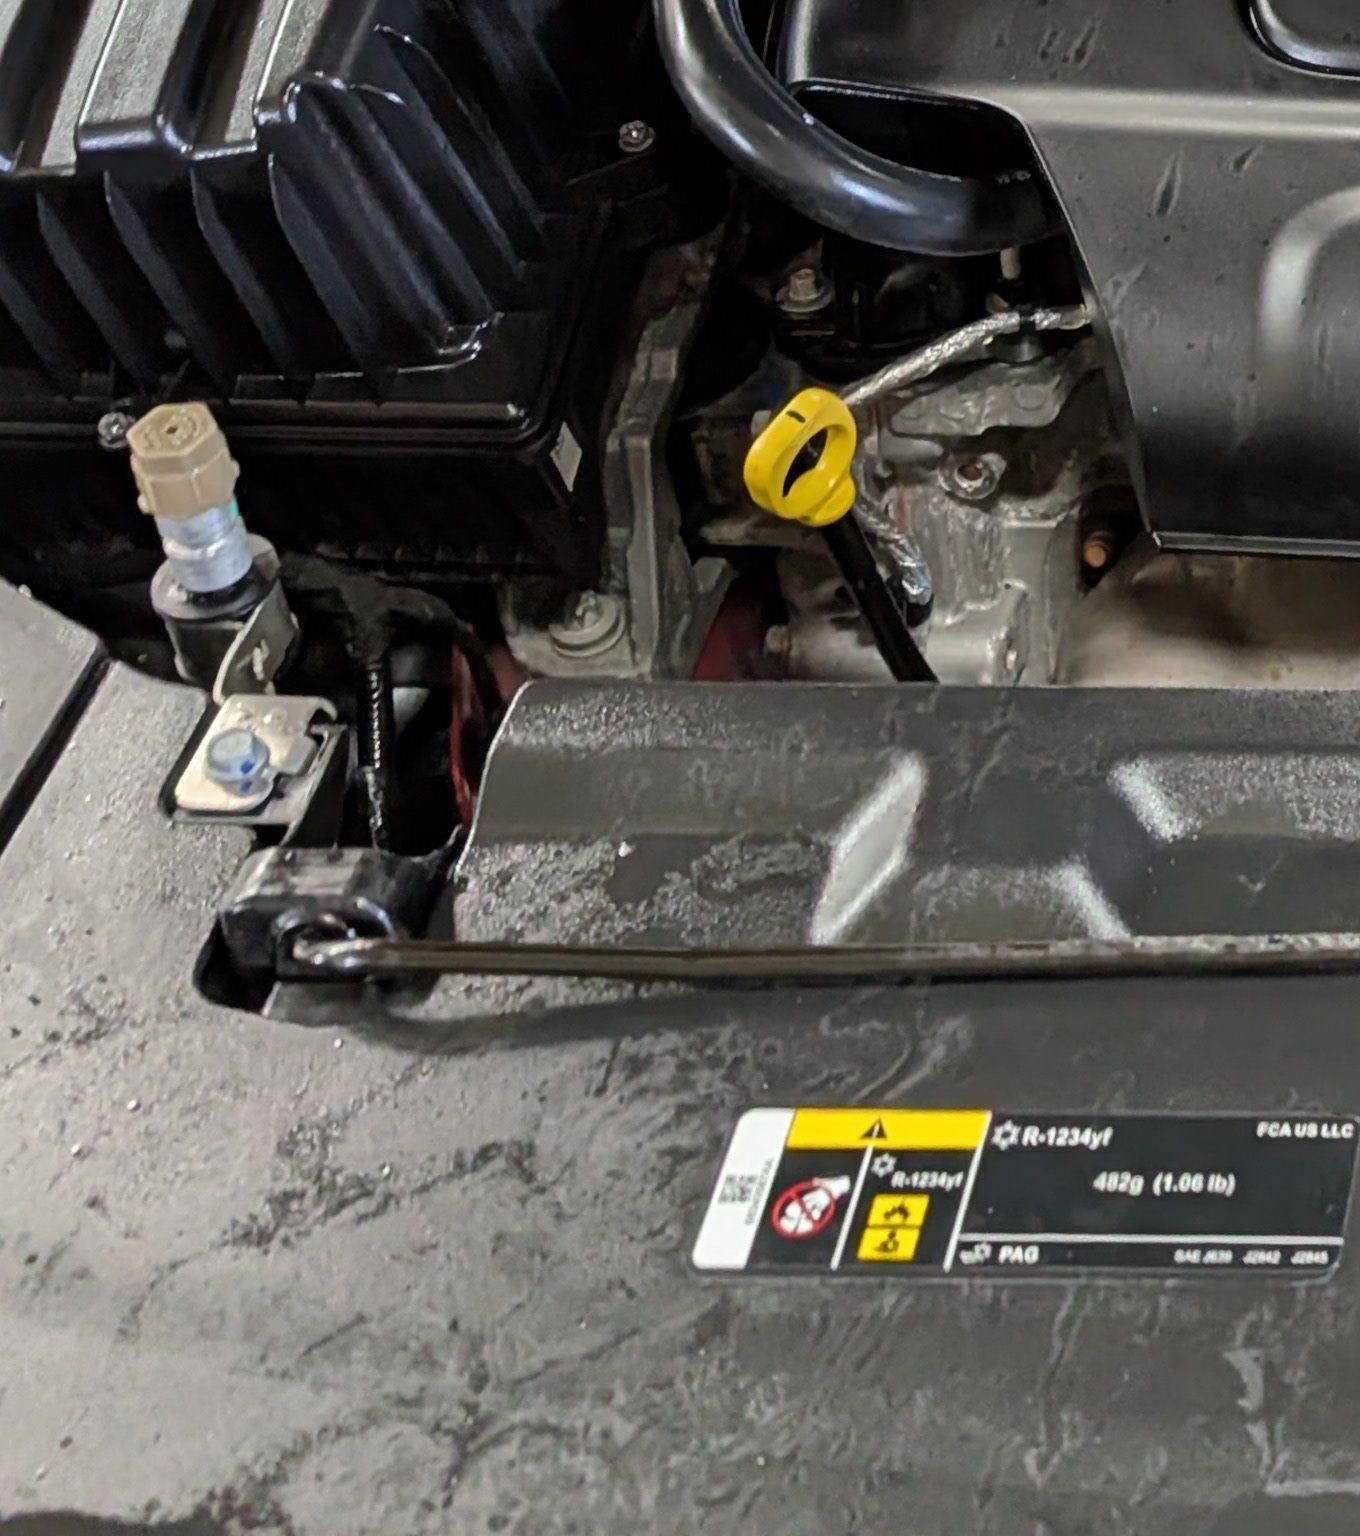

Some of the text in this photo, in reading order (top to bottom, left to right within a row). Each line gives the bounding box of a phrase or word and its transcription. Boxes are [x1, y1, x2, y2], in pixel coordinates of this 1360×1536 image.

[1022, 1125, 1114, 1151] R-1234yf
[1256, 1121, 1355, 1139] FCA US LLC
[891, 1170, 965, 1192] R-1234yf
[1092, 1171, 1145, 1197] 482g
[998, 1244, 1040, 1264] PAG
